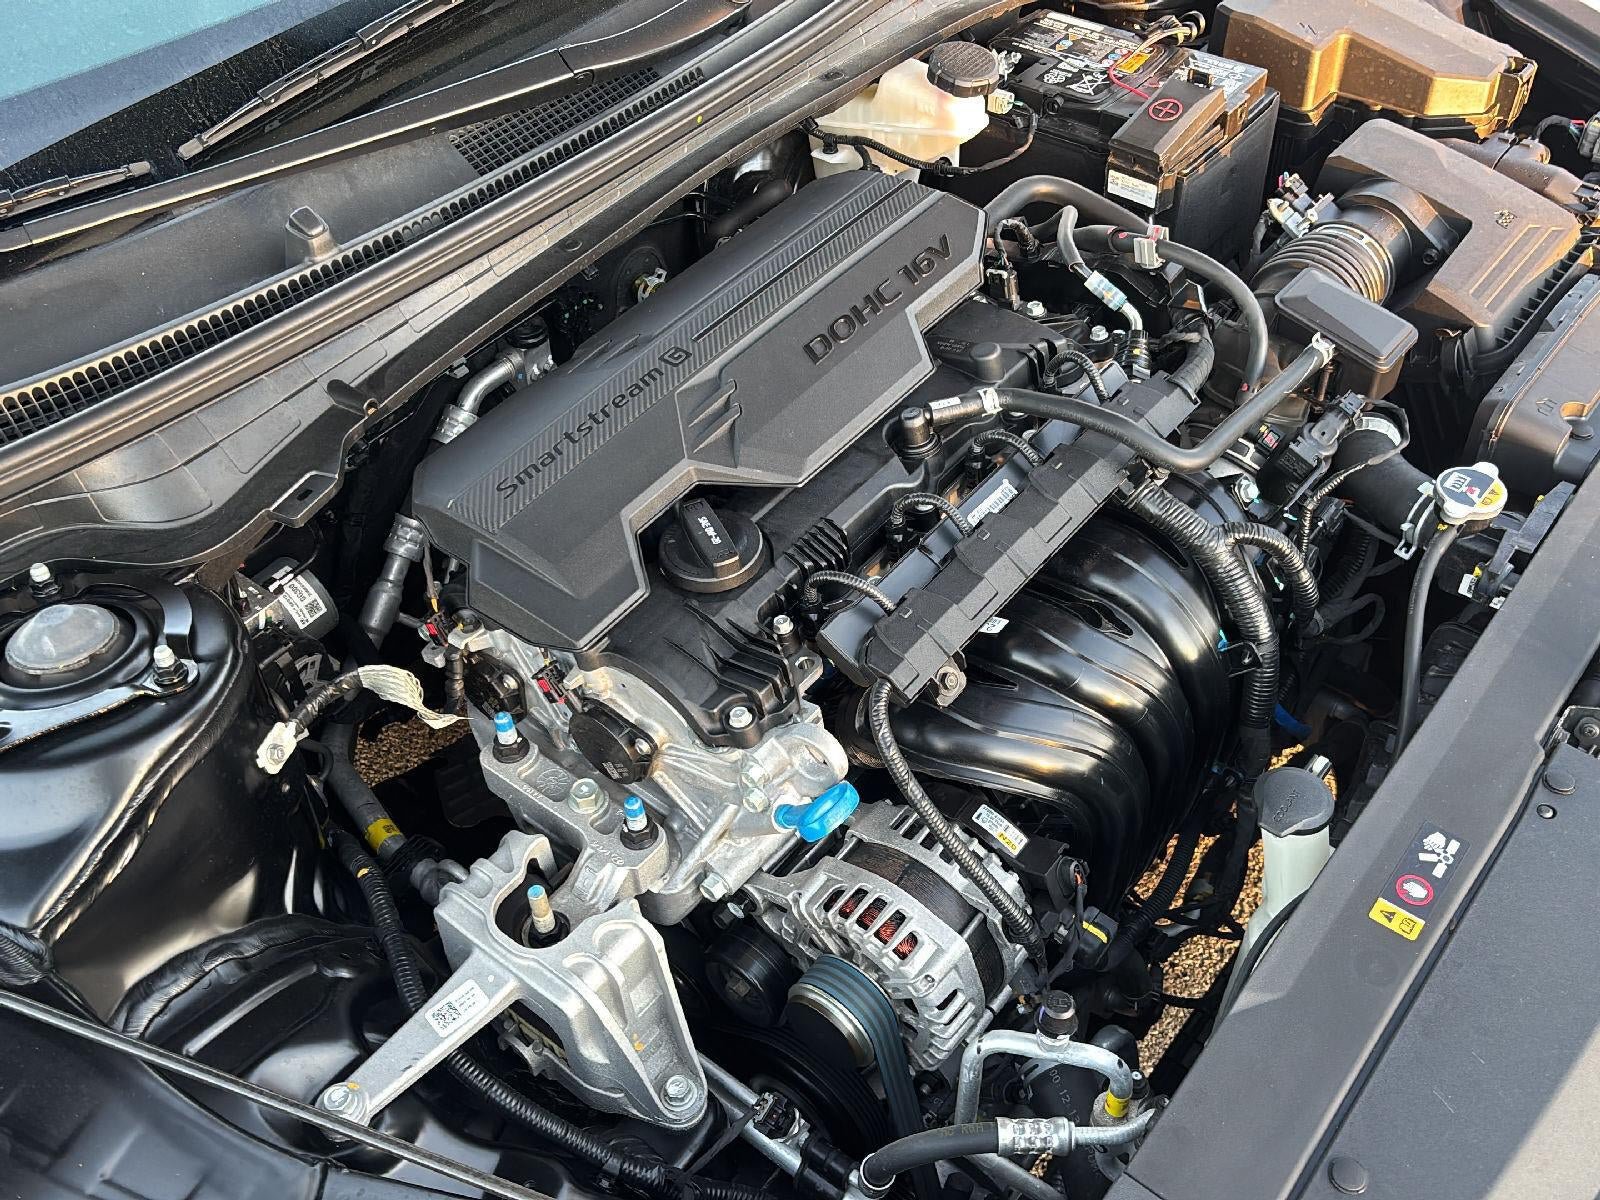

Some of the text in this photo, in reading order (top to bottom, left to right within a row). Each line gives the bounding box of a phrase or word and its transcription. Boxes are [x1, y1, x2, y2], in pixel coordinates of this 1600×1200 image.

[802, 233, 951, 365] DOHC 16V
[496, 367, 664, 499] Smartstream
